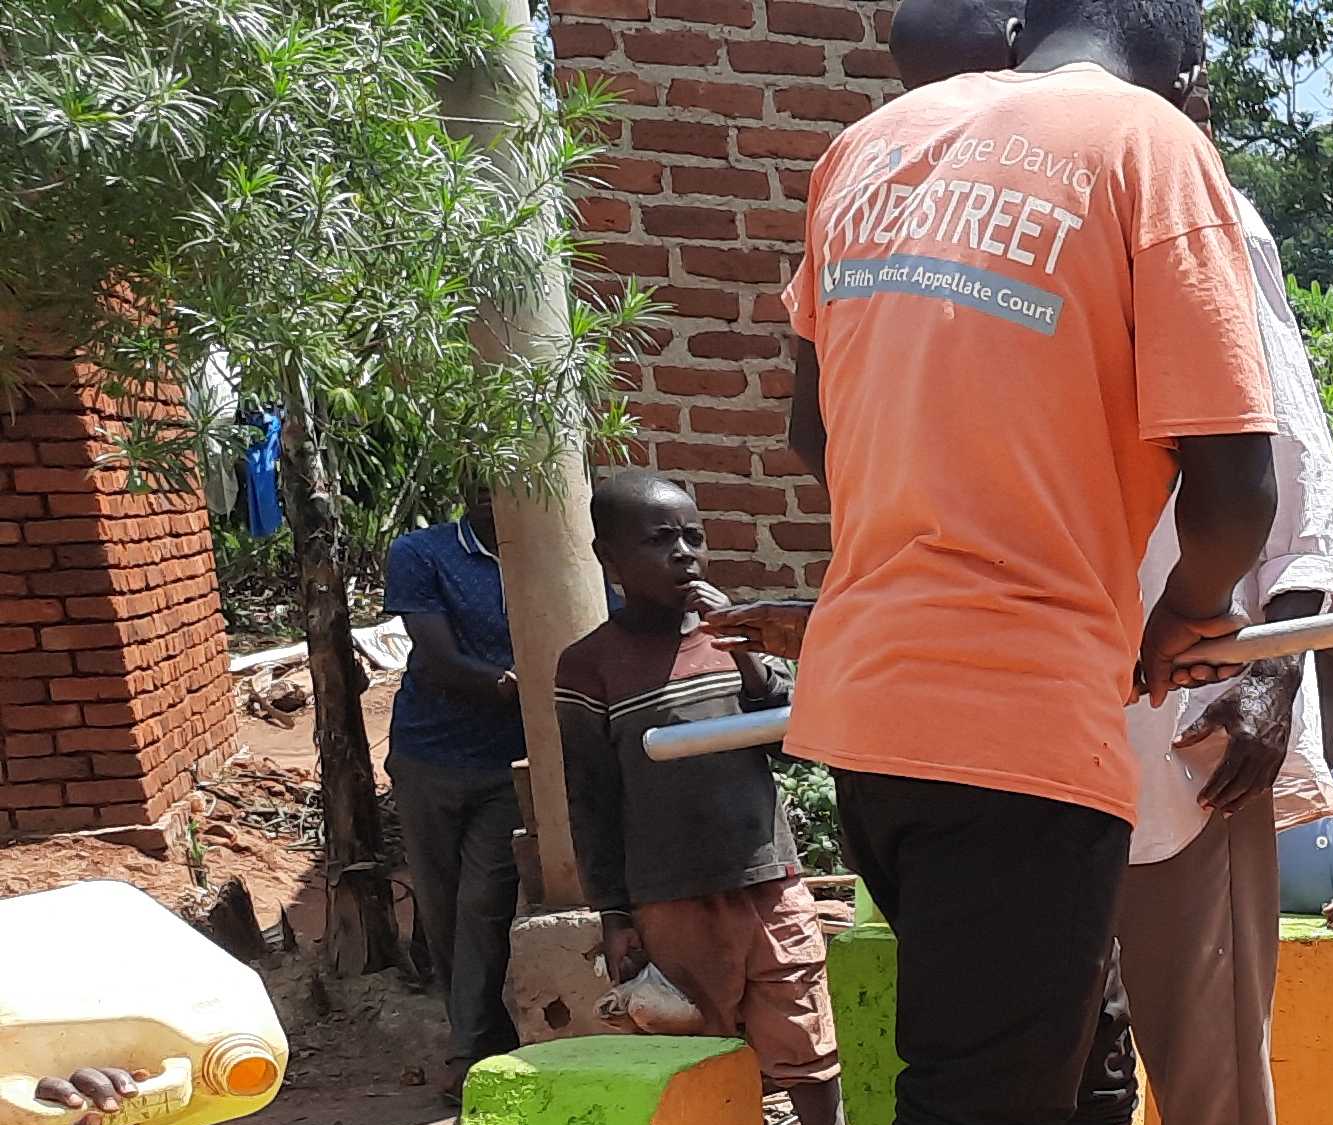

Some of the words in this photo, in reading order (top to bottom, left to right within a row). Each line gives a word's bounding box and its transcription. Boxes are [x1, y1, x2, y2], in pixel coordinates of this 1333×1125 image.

[1000, 134, 1099, 196] David
[911, 265, 993, 302] Appellate
[996, 288, 1058, 325] Court
